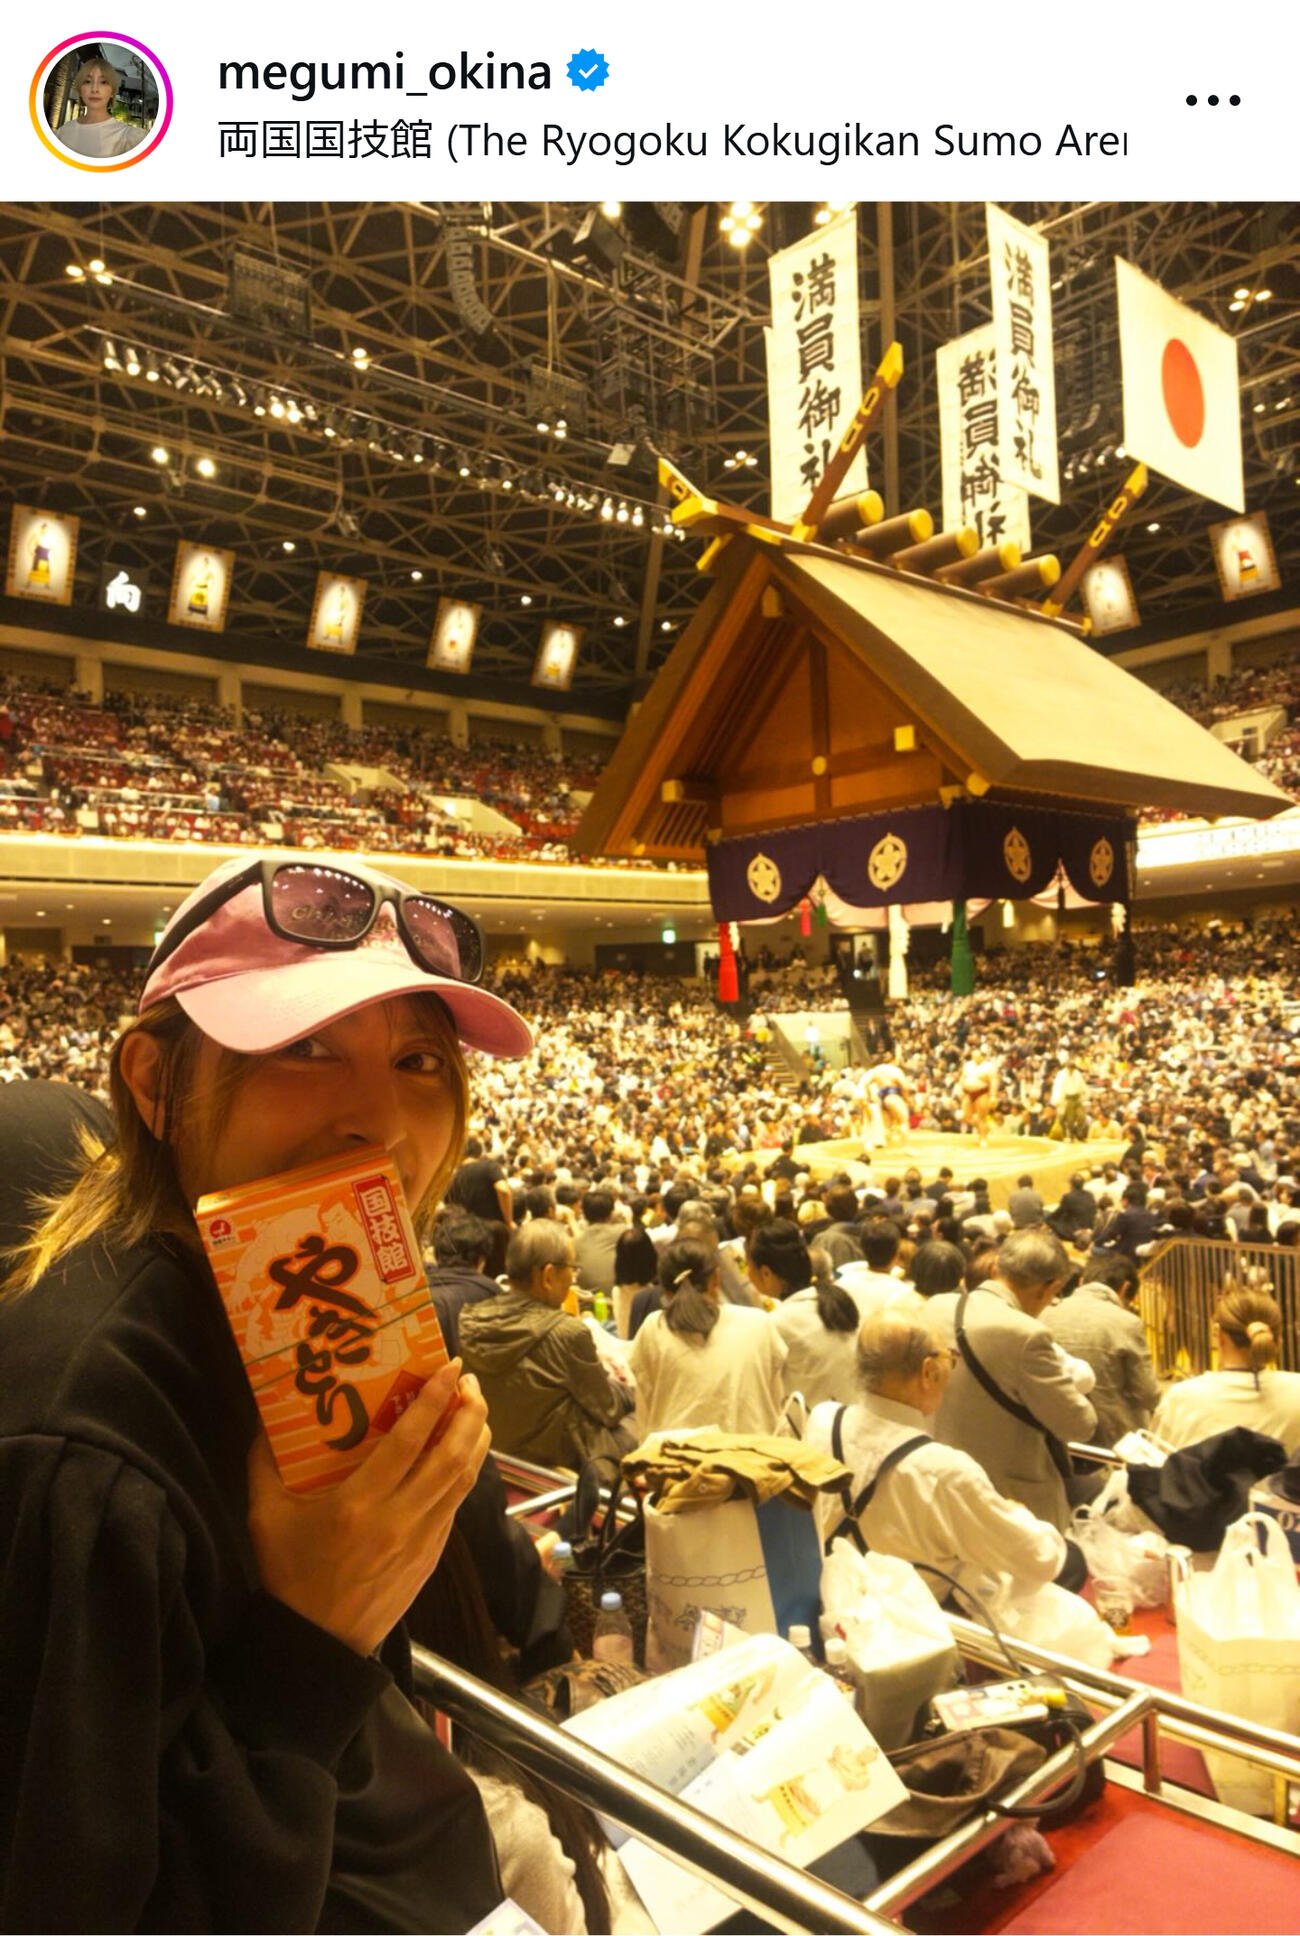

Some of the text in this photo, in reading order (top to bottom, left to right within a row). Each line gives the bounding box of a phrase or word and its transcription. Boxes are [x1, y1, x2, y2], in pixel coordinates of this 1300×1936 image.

[1004, 242, 1043, 481] 満員御礼
[360, 1186, 409, 1275] 国技館
[269, 1235, 379, 1451] やきとり
